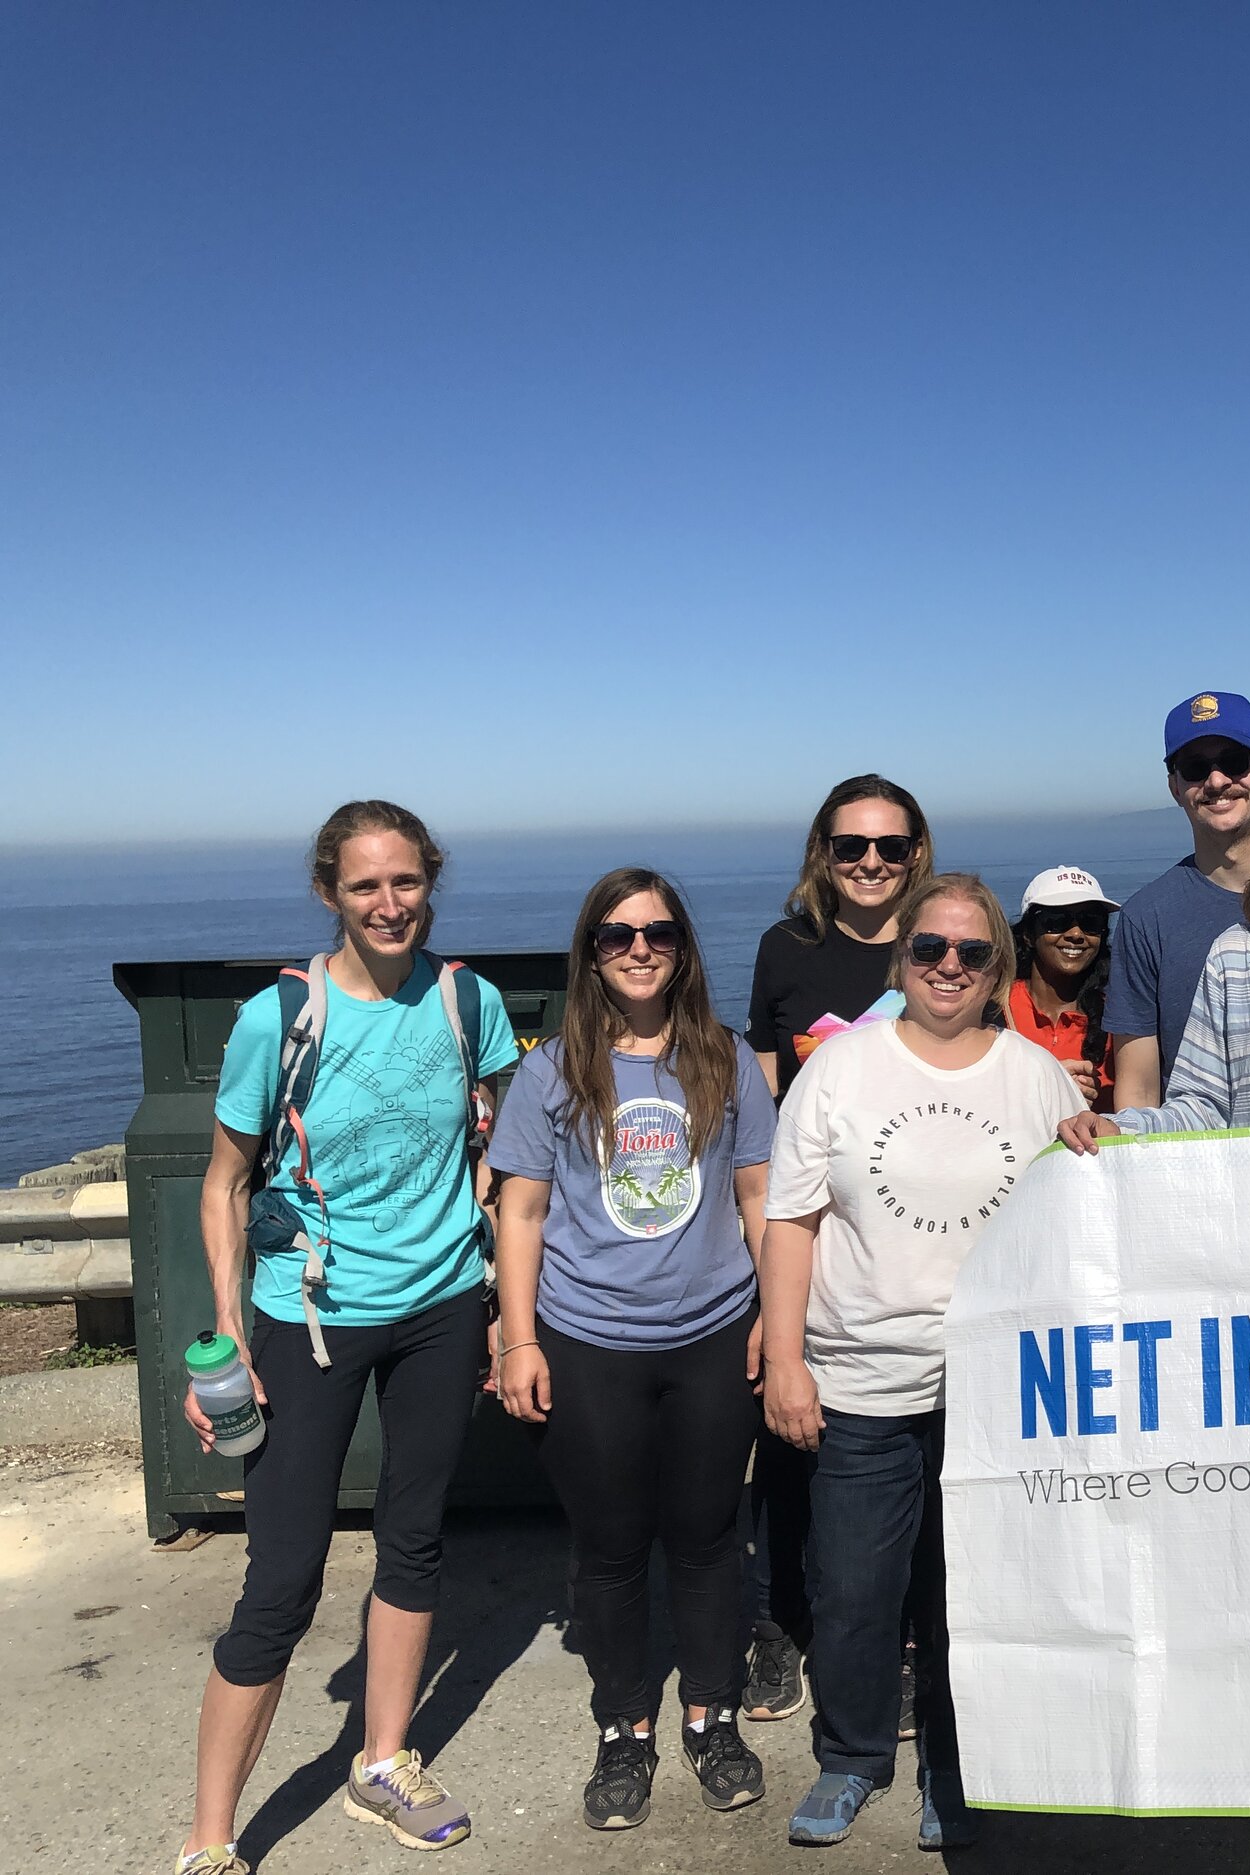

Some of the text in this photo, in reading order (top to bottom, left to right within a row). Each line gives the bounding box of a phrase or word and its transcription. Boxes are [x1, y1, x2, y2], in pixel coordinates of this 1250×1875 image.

[1070, 872, 1092, 886] OPEN
[616, 1126, 677, 1153] Toña
[870, 1103, 1016, 1234] THERE IS NO PLAN B FOR OUR PLANET
[1019, 1320, 1172, 1439] NET
[213, 1416, 238, 1426] orts
[1018, 1466, 1151, 1504] Where
